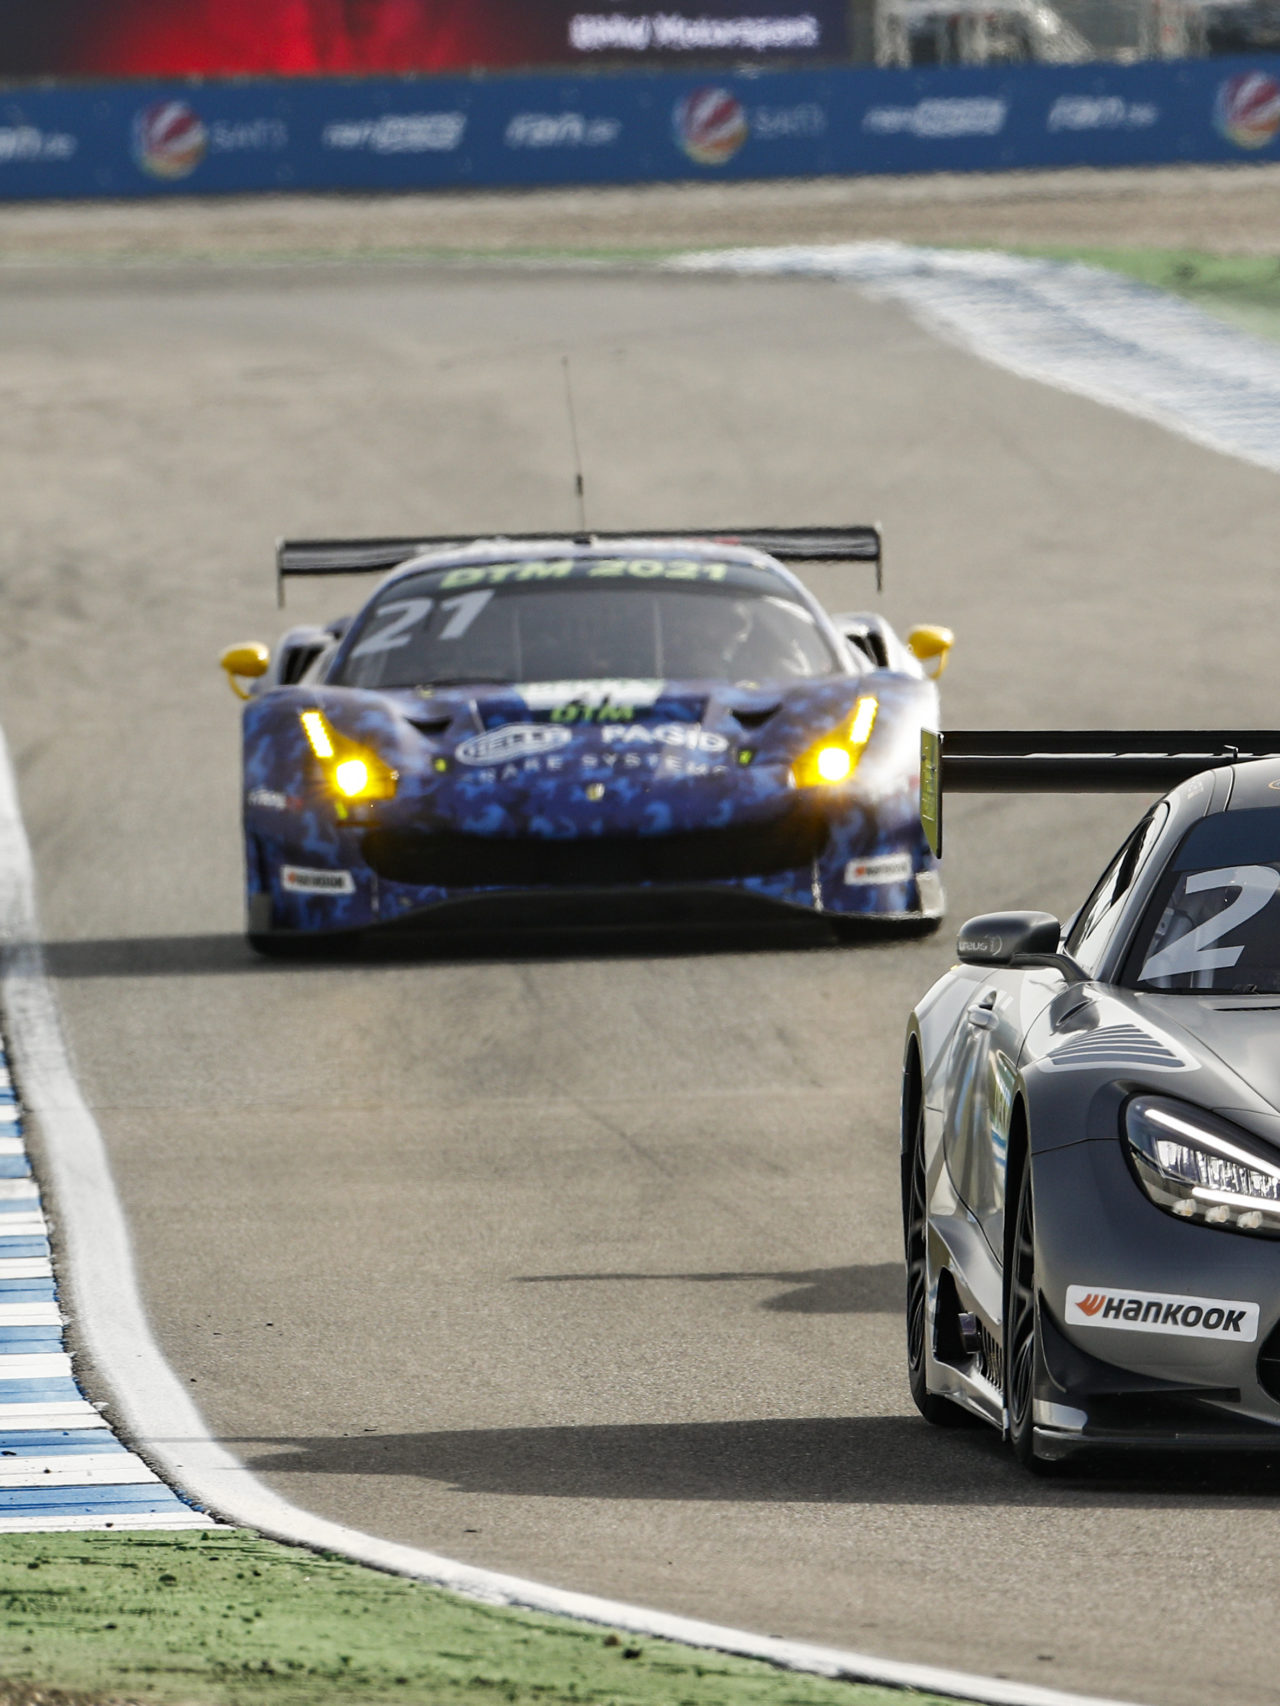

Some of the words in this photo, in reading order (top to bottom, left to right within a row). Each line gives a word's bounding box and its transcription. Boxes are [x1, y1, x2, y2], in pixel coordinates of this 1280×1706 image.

[440, 560, 575, 589] DTM
[586, 559, 728, 582] 2021
[352, 588, 496, 659] 21
